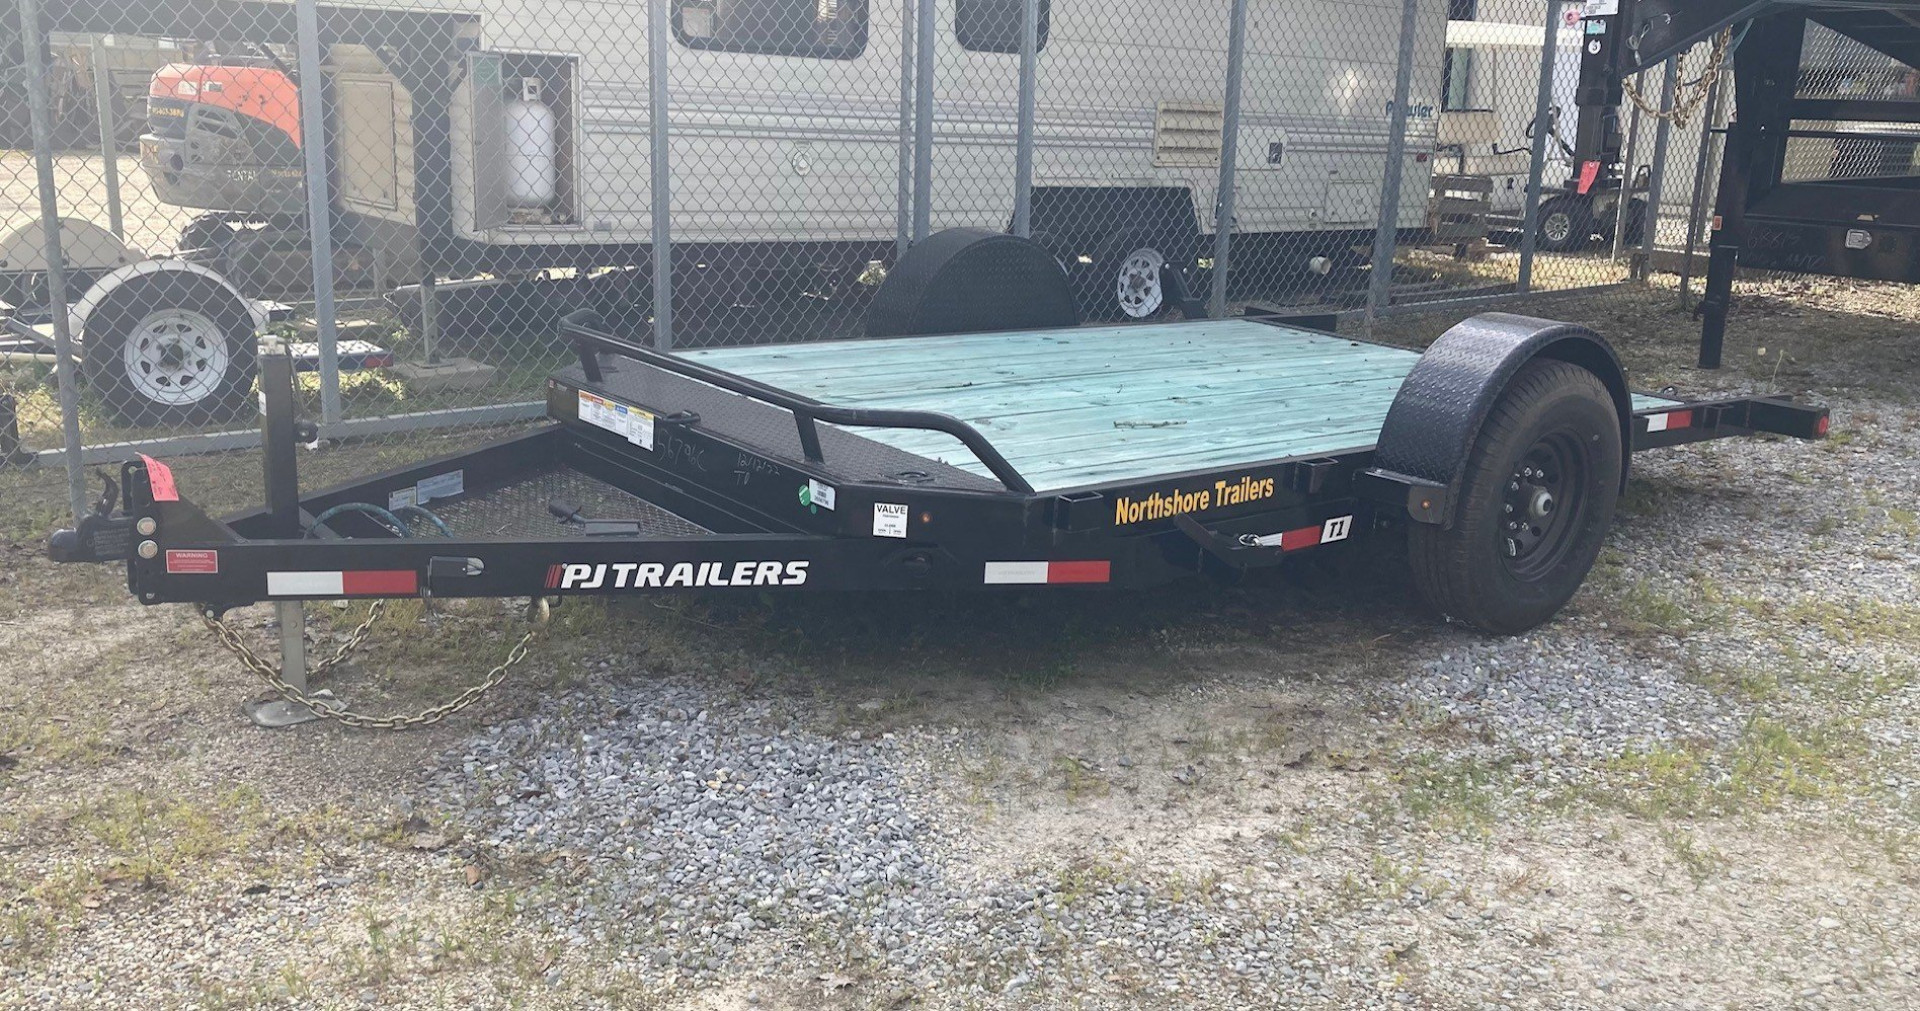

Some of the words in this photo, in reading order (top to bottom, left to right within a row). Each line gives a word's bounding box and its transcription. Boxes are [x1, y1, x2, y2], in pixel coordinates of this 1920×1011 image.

[1386, 101, 1433, 117] Pwler
[876, 504, 906, 515] VALVE
[1115, 488, 1209, 525] Northshore
[1215, 476, 1274, 507] Trailers
[1330, 520, 1345, 539] T1
[561, 563, 607, 589] PJ
[612, 561, 809, 588] TRAILERS
